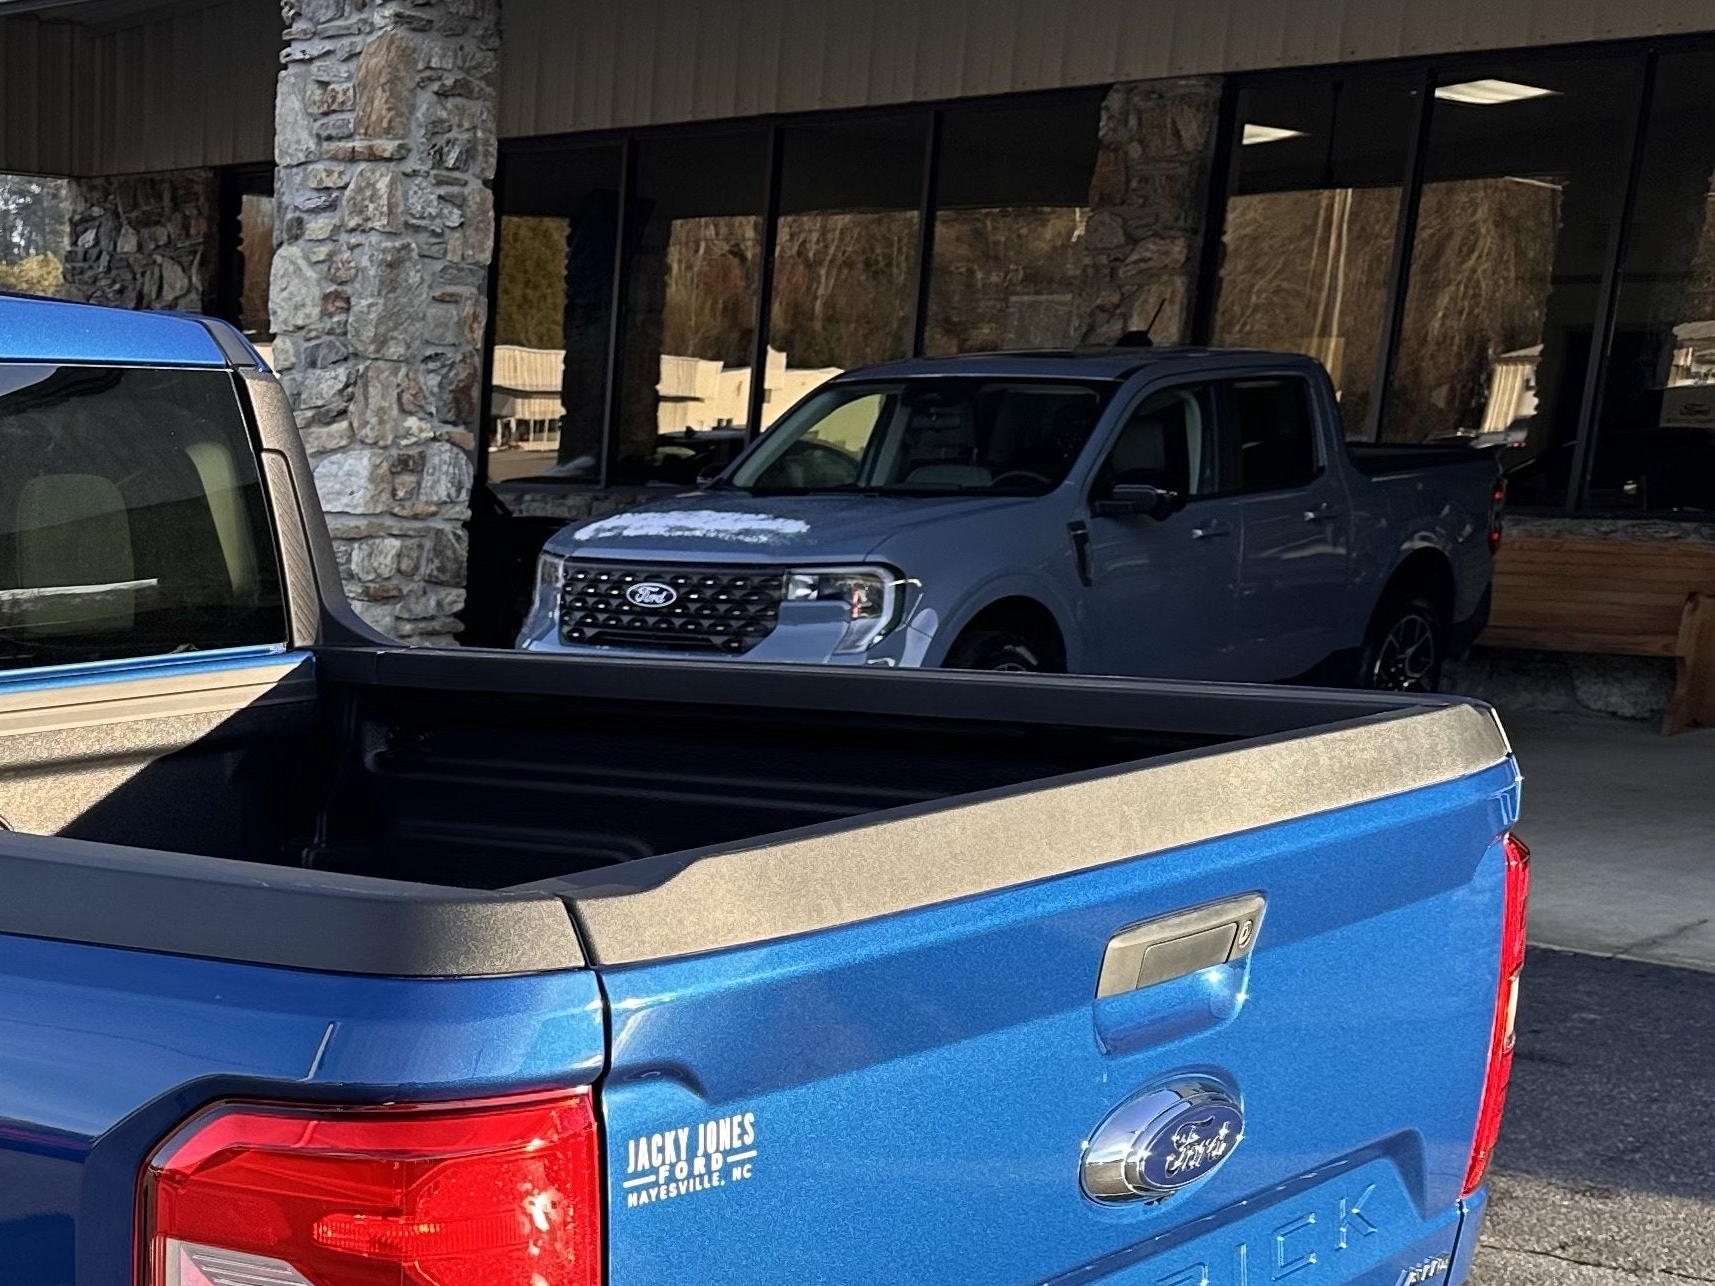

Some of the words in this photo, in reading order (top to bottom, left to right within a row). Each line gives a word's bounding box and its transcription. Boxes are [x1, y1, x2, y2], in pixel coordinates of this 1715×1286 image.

[634, 586, 668, 604] Ford
[627, 1126, 690, 1174] JACKY
[696, 1112, 756, 1157] JONES
[658, 1152, 724, 1185] FORD
[732, 1164, 753, 1182] NC
